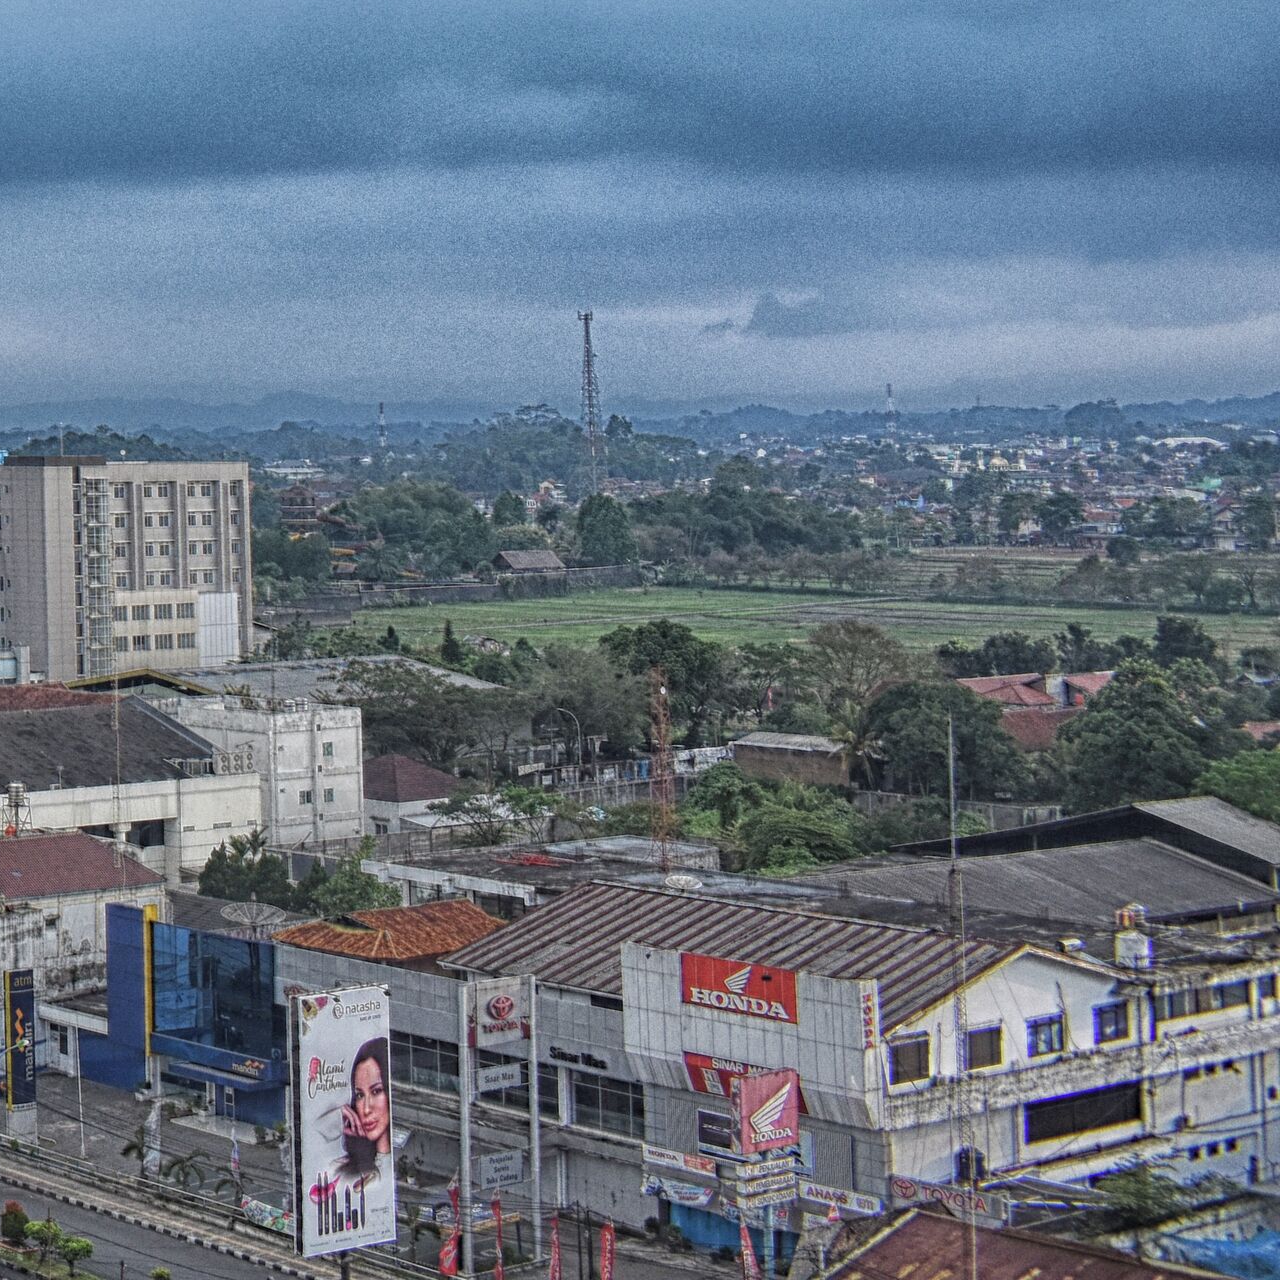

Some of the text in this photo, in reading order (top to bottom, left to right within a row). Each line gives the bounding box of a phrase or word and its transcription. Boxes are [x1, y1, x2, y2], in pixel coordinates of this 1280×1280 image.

[13, 976, 33, 988] atm
[345, 1001, 381, 1015] natasha
[690, 987, 790, 1019] HONDA
[482, 1020, 519, 1034] TOYOTA
[549, 1046, 608, 1070] Sinar Mas
[711, 1057, 744, 1074] SINAR
[501, 1071, 515, 1082] Mas
[751, 1127, 793, 1144] HONDA
[647, 1148, 679, 1162] HONDA
[922, 1186, 987, 1213] TOYOTA
